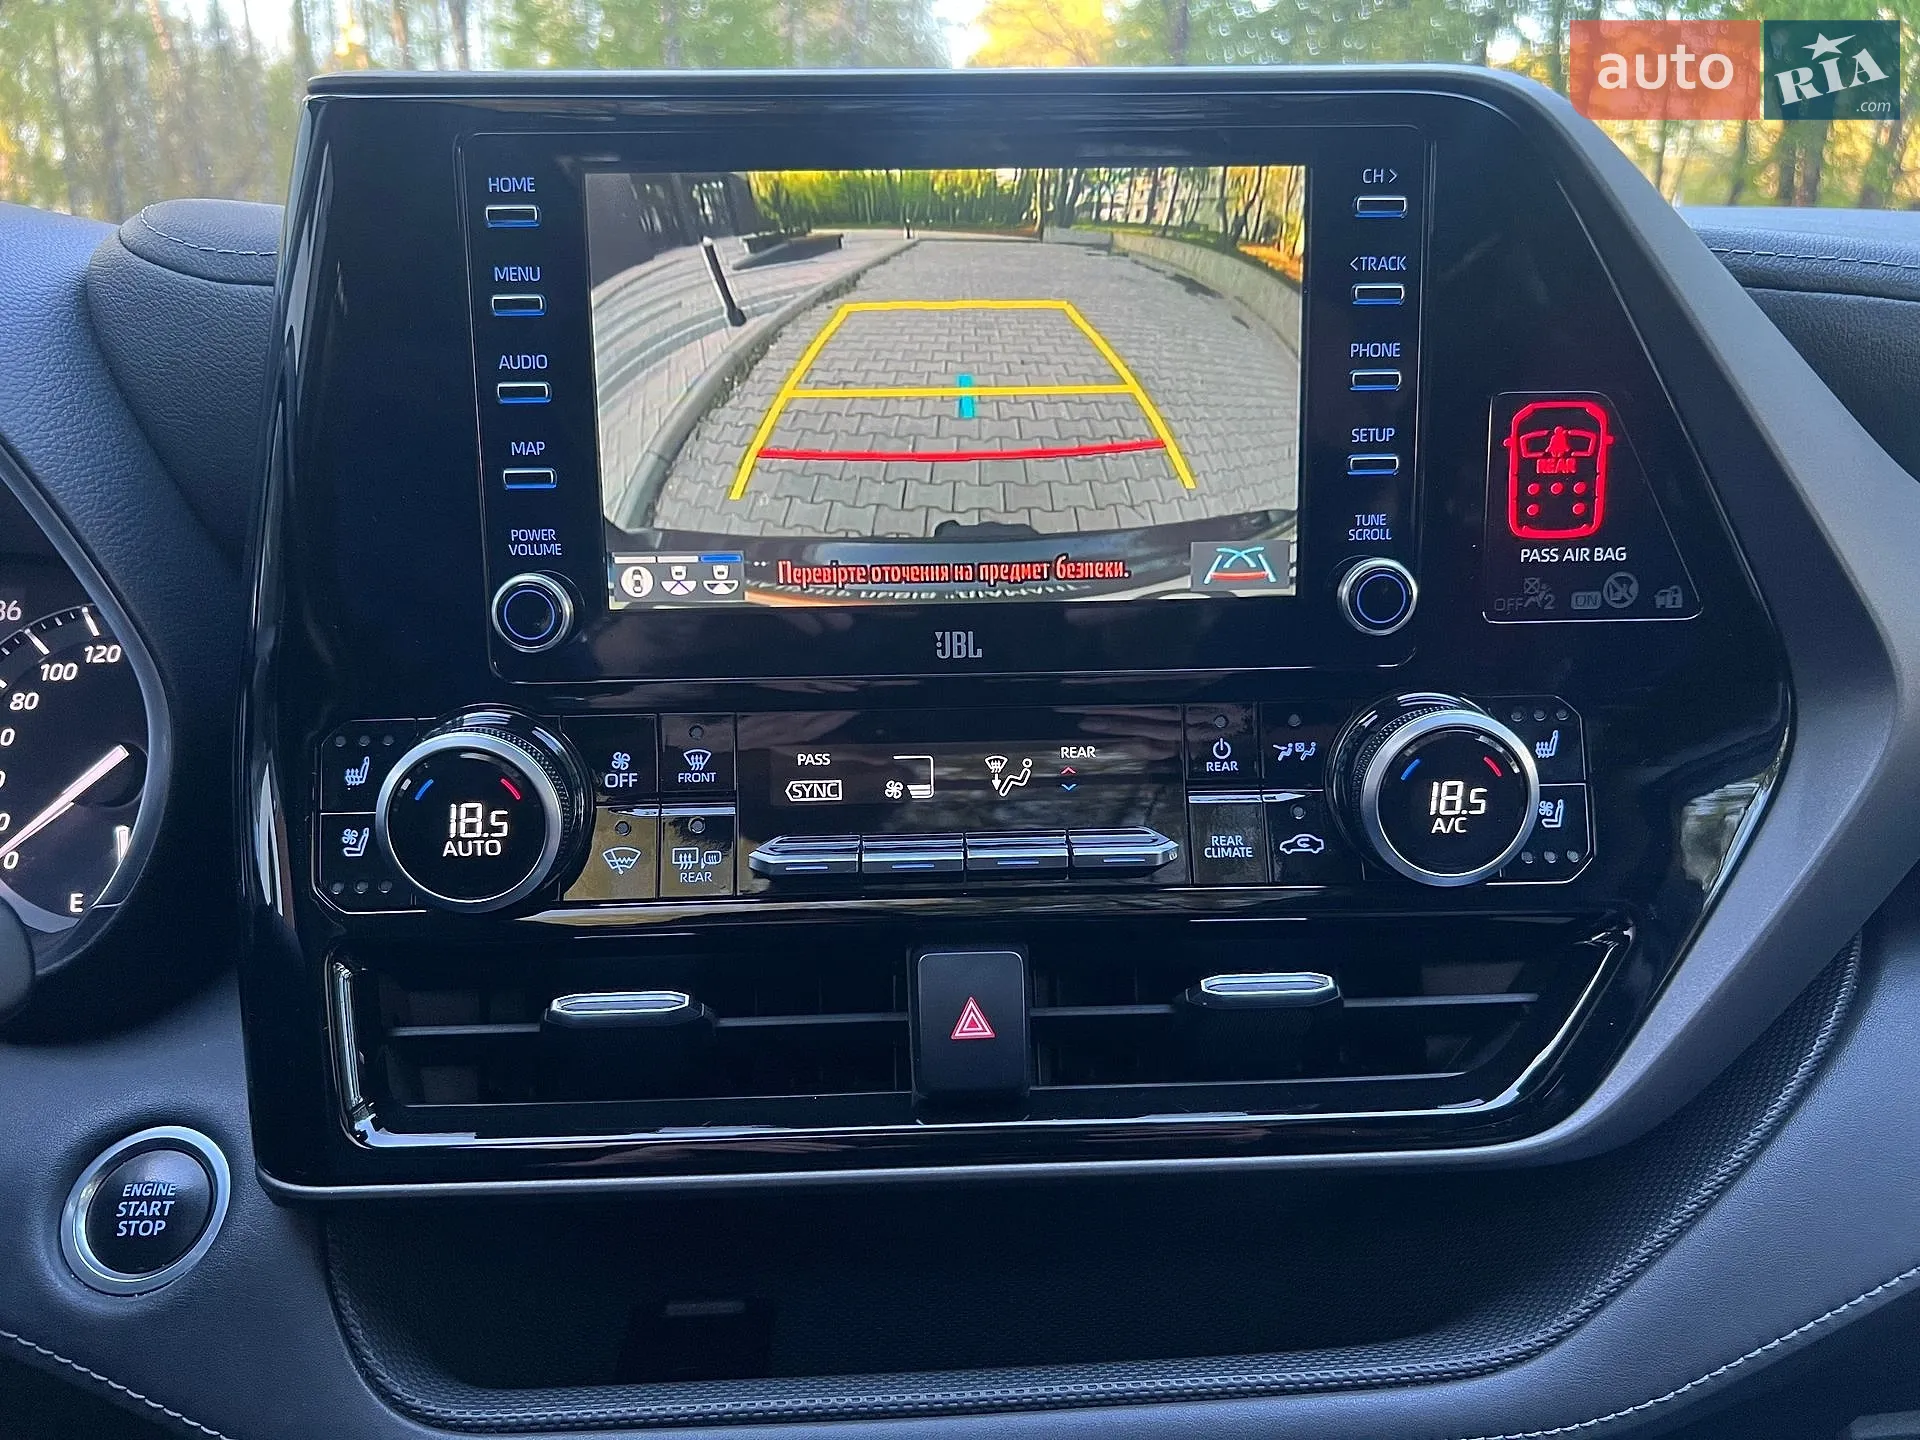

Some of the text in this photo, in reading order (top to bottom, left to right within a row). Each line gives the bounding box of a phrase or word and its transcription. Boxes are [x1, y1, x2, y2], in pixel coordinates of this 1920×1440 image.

[487, 176, 536, 193] HOME
[493, 266, 541, 282] MENU
[1350, 342, 1401, 358] PHONE
[498, 354, 548, 370] AUDIO
[1351, 428, 1395, 443] SETUP
[511, 441, 545, 456] MAP
[1355, 514, 1386, 526] TUNE
[510, 529, 557, 542] POWER
[1348, 527, 1392, 541] SCROLL
[508, 541, 562, 556] VOLUME
[1520, 546, 1627, 563] PASS AIR BAG
[778, 555, 1130, 589] Перевірте оточення на предмет безпеки.
[935, 631, 983, 659] JBL
[84, 645, 121, 663] 120
[40, 663, 78, 681] 100
[9, 692, 39, 711] 80
[797, 752, 831, 766] PASS
[1060, 745, 1096, 759] REAR
[1206, 760, 1239, 772] REAR
[605, 773, 638, 788] OFF
[677, 771, 717, 784] FRONT
[791, 782, 838, 799] SYNC
[1429, 780, 1488, 816] 18.5
[448, 802, 509, 839] 18.5
[1431, 816, 1467, 834] A/C
[442, 839, 502, 857] AUTO
[1210, 835, 1243, 847] REAR
[3, 851, 19, 870] 0
[1204, 846, 1253, 859] CLIMATE
[679, 871, 713, 883] REAR
[69, 892, 84, 913] E
[122, 1183, 176, 1197] ENGINE
[116, 1200, 175, 1217] START
[116, 1219, 166, 1237] STOP
